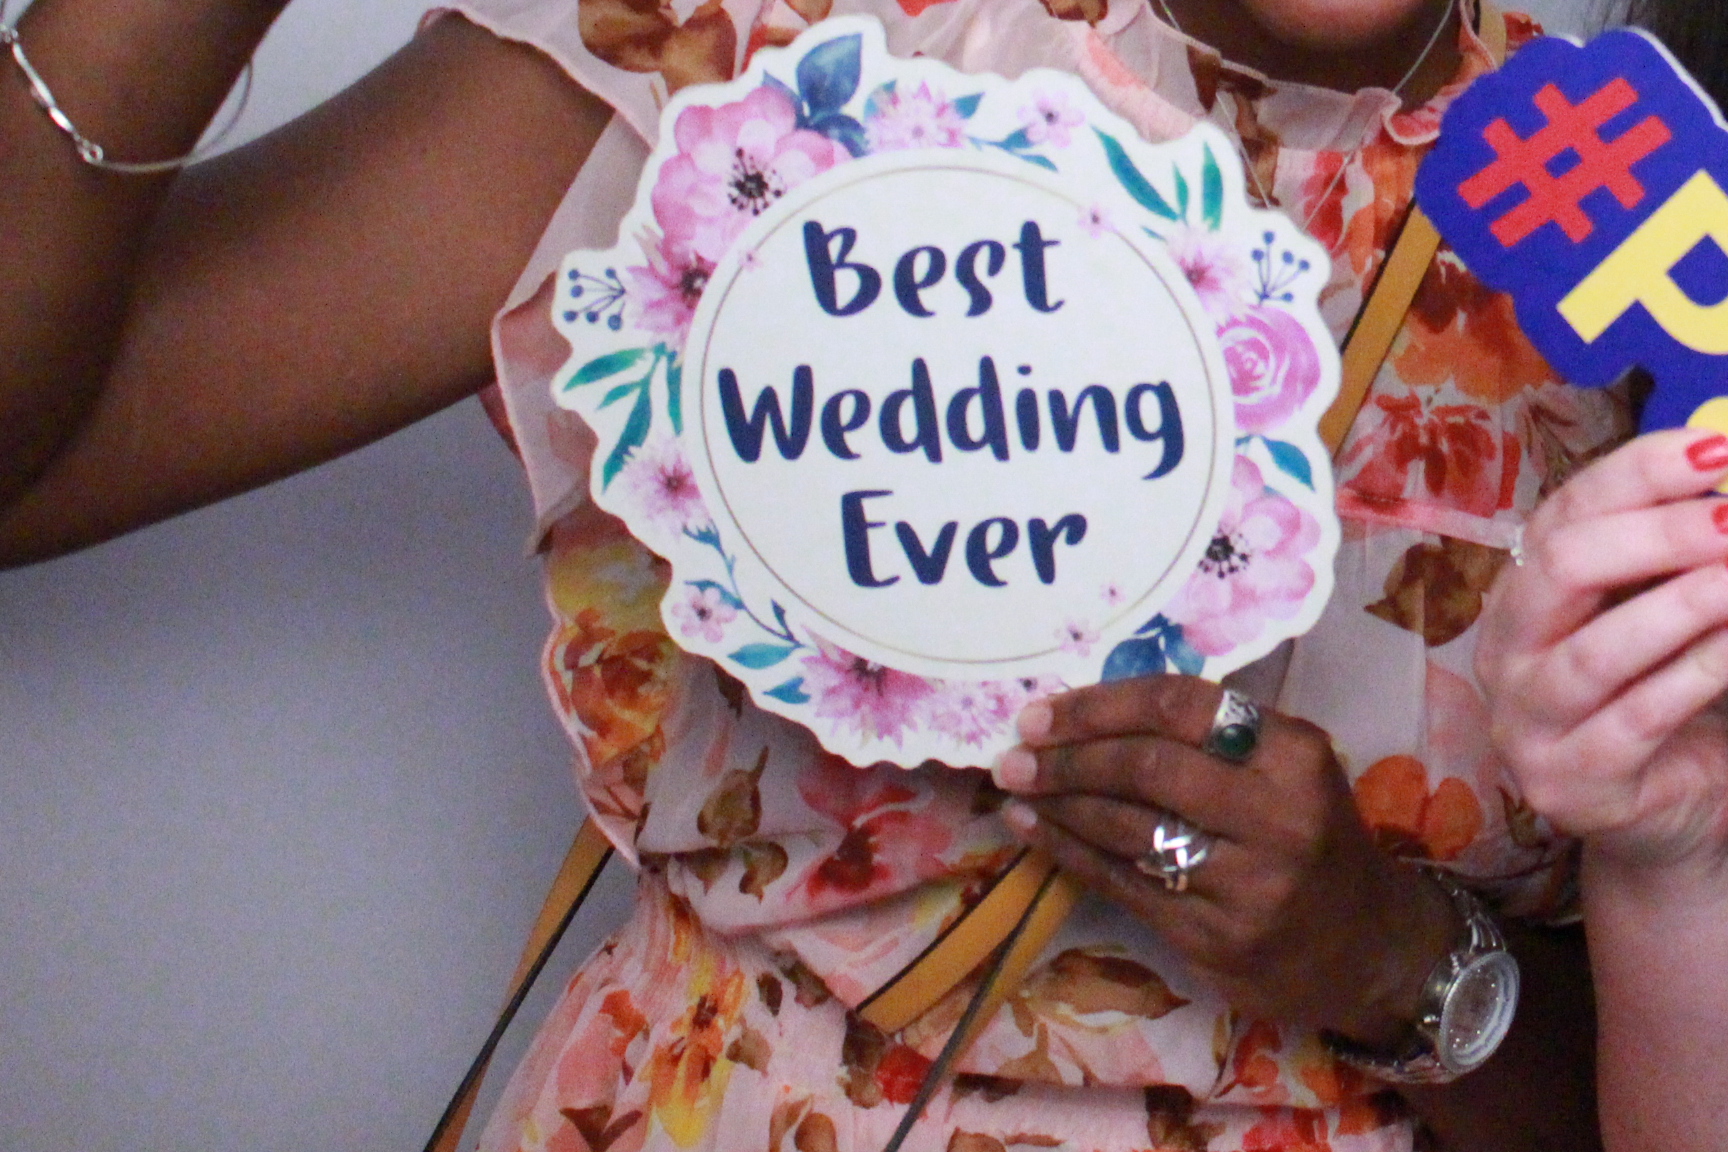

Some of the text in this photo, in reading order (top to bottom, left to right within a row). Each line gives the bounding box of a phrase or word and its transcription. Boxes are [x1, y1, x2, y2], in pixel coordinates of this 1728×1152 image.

[802, 220, 1064, 318] Best
[716, 355, 1186, 480] Wedding
[840, 489, 1088, 589] Ever
